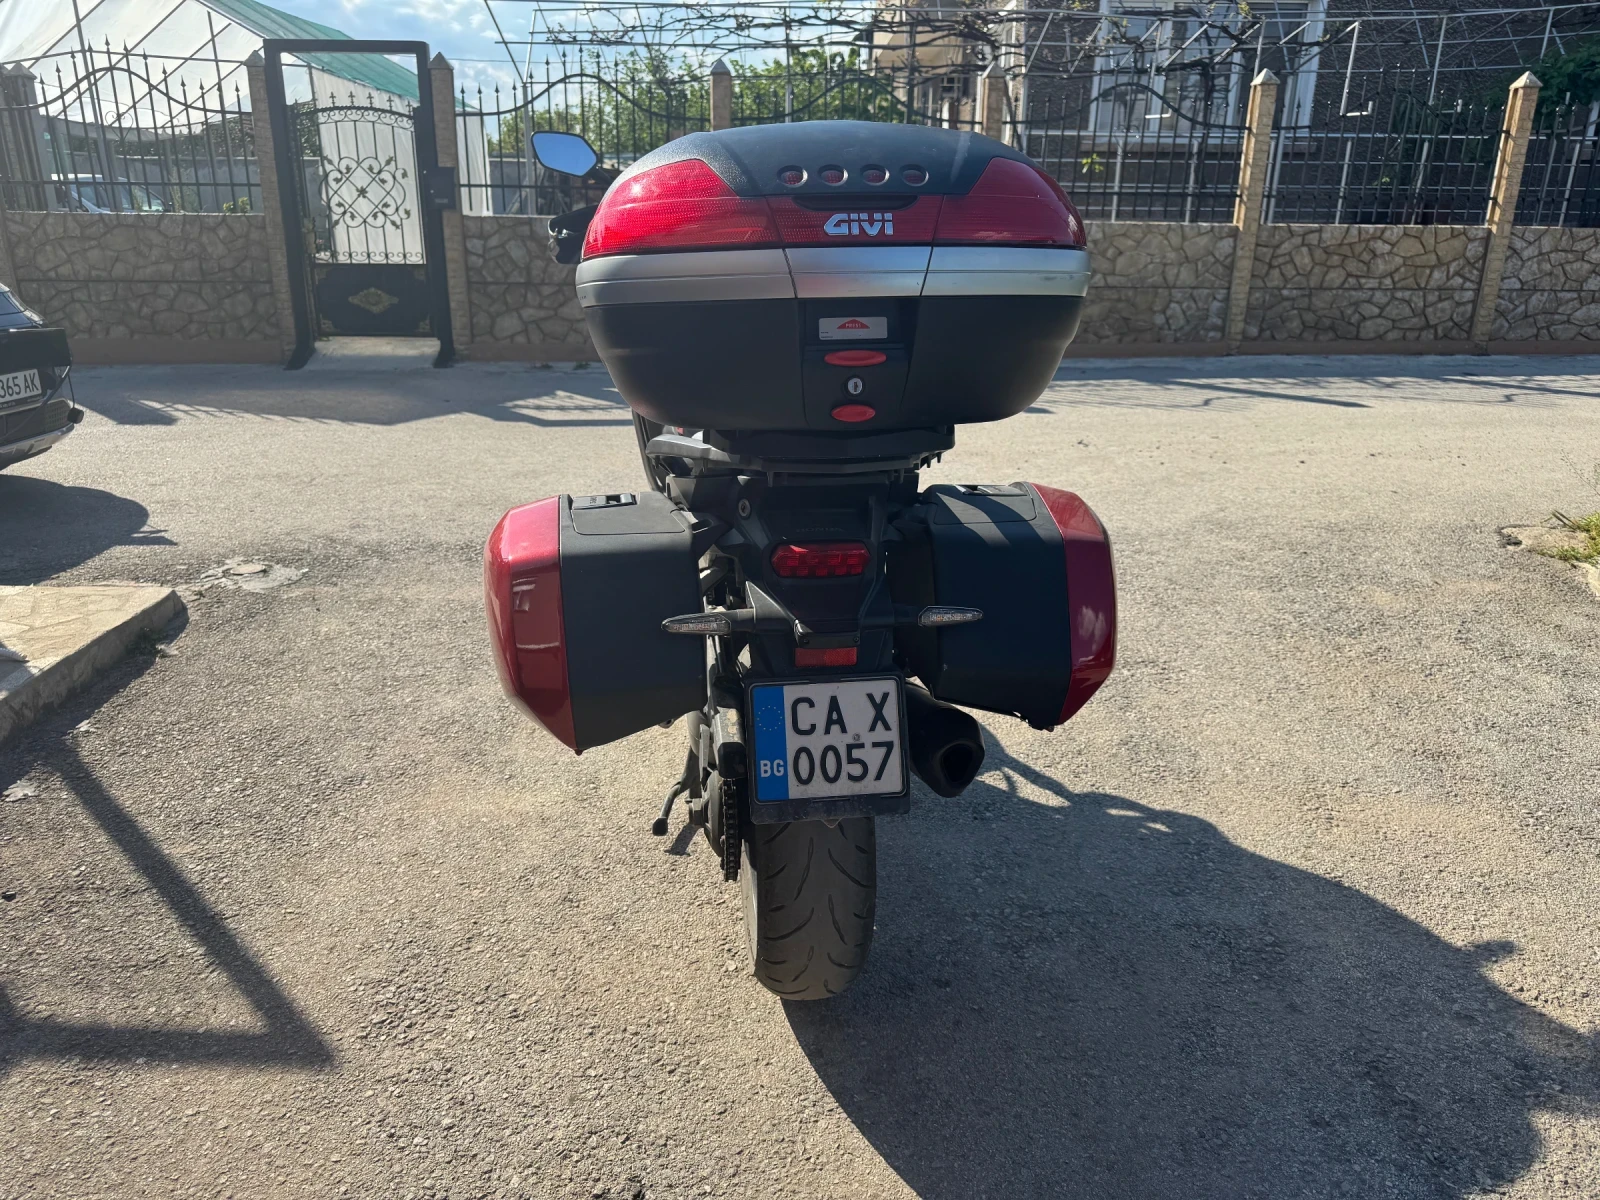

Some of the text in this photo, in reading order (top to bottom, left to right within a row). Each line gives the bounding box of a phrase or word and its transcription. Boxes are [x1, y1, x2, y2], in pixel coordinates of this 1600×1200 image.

[823, 213, 894, 236] GIVI
[24, 372, 39, 394] AK
[791, 692, 892, 736] CA X
[760, 759, 785, 778] BG
[793, 741, 894, 785] 0057
